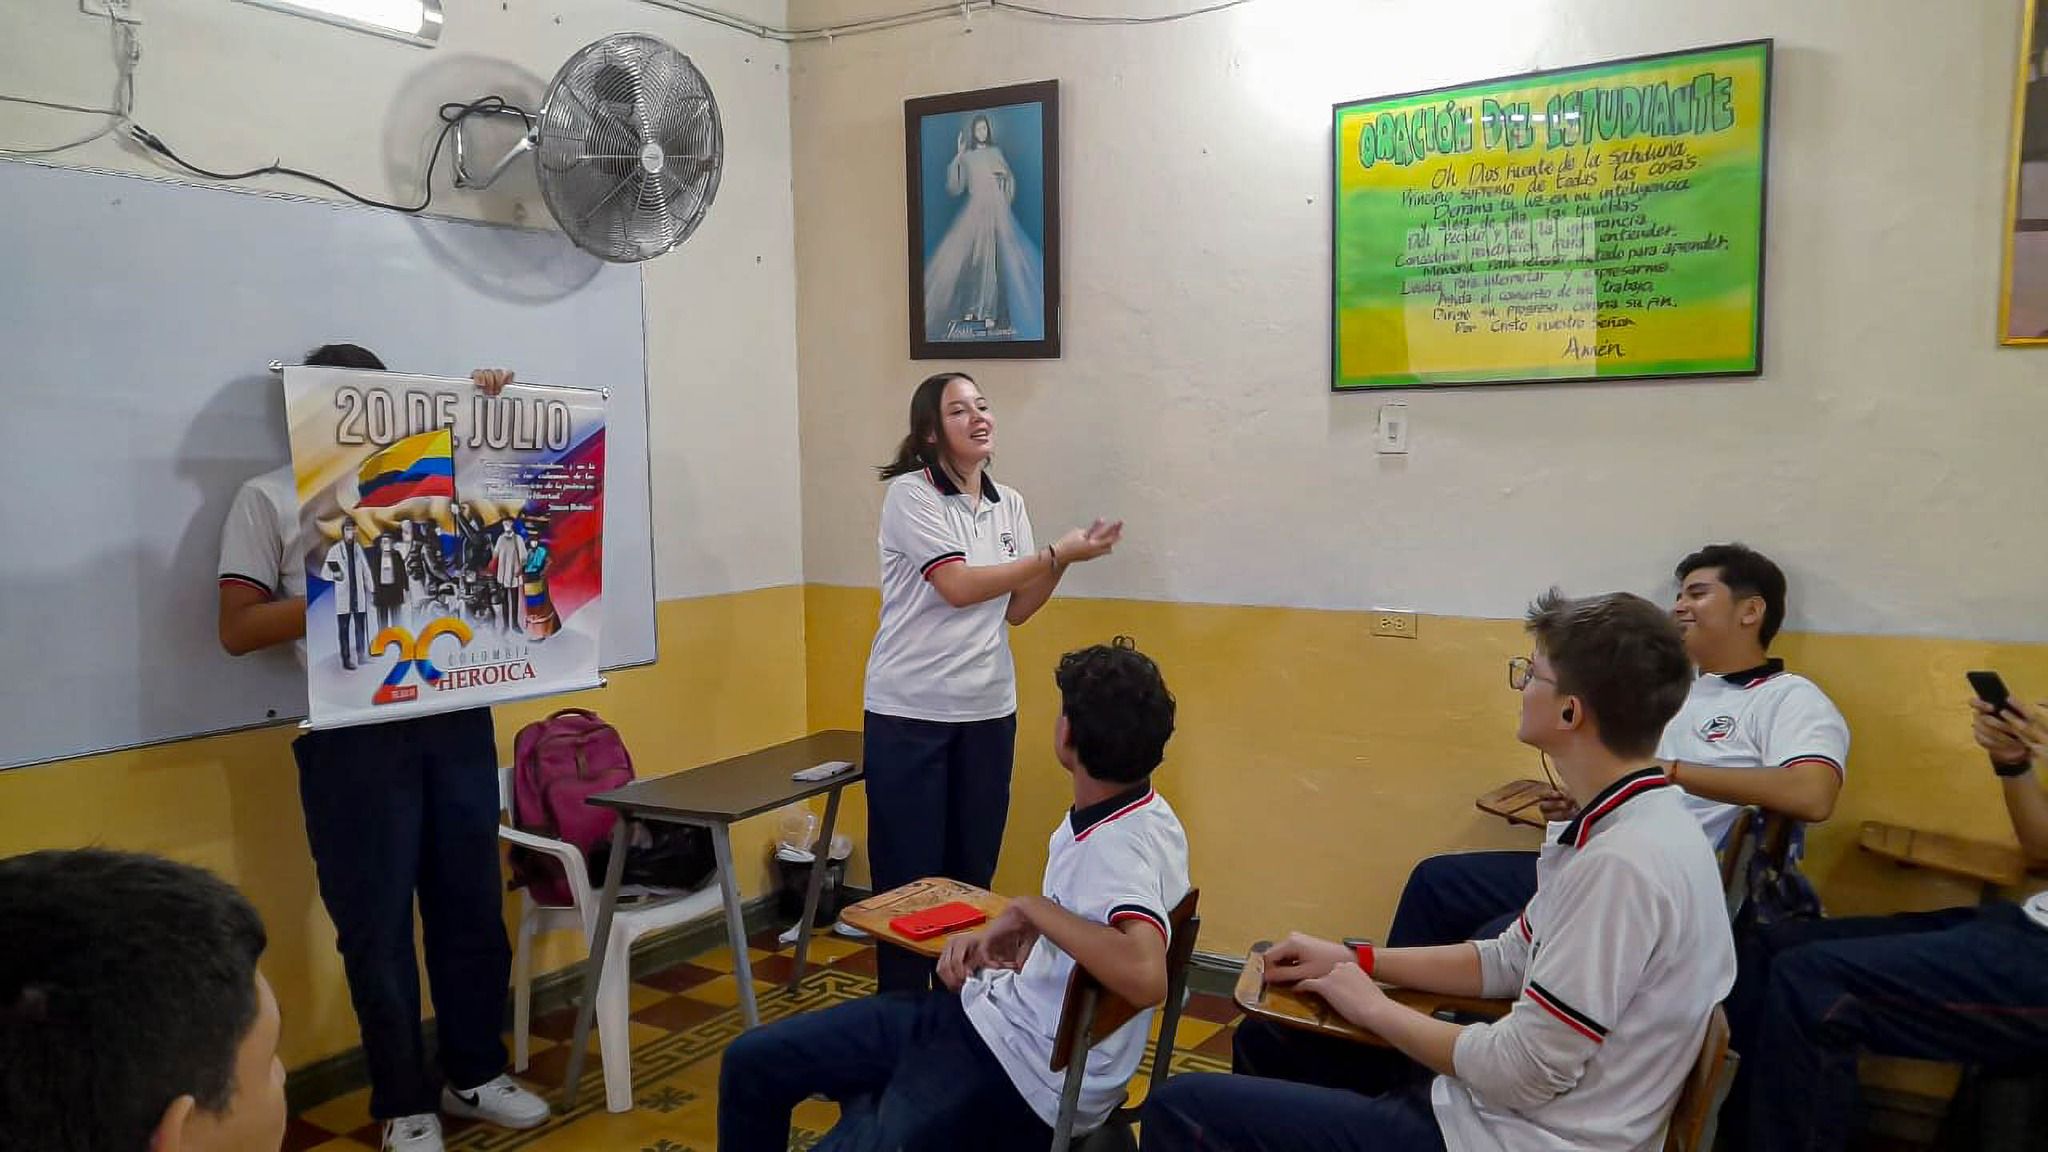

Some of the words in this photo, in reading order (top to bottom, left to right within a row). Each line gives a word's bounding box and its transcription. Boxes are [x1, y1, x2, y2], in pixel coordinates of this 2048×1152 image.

[1359, 100, 1472, 168] ORACIÓN
[1482, 98, 1536, 152] DEL
[1546, 72, 1735, 151] ESTUDIANTE
[1431, 163, 1458, 189] Oh
[1469, 161, 1499, 188] Dios
[1559, 151, 1575, 173] de
[1584, 148, 1600, 169] la
[1527, 179, 1546, 193] de
[1556, 169, 1598, 189] todas
[1612, 164, 1637, 182] las
[1500, 199, 1517, 212] tu
[1624, 298, 1643, 308] su
[336, 386, 395, 447] 20
[405, 390, 460, 447] DE
[468, 394, 571, 452] JULIO
[437, 661, 536, 692] HEROICA
